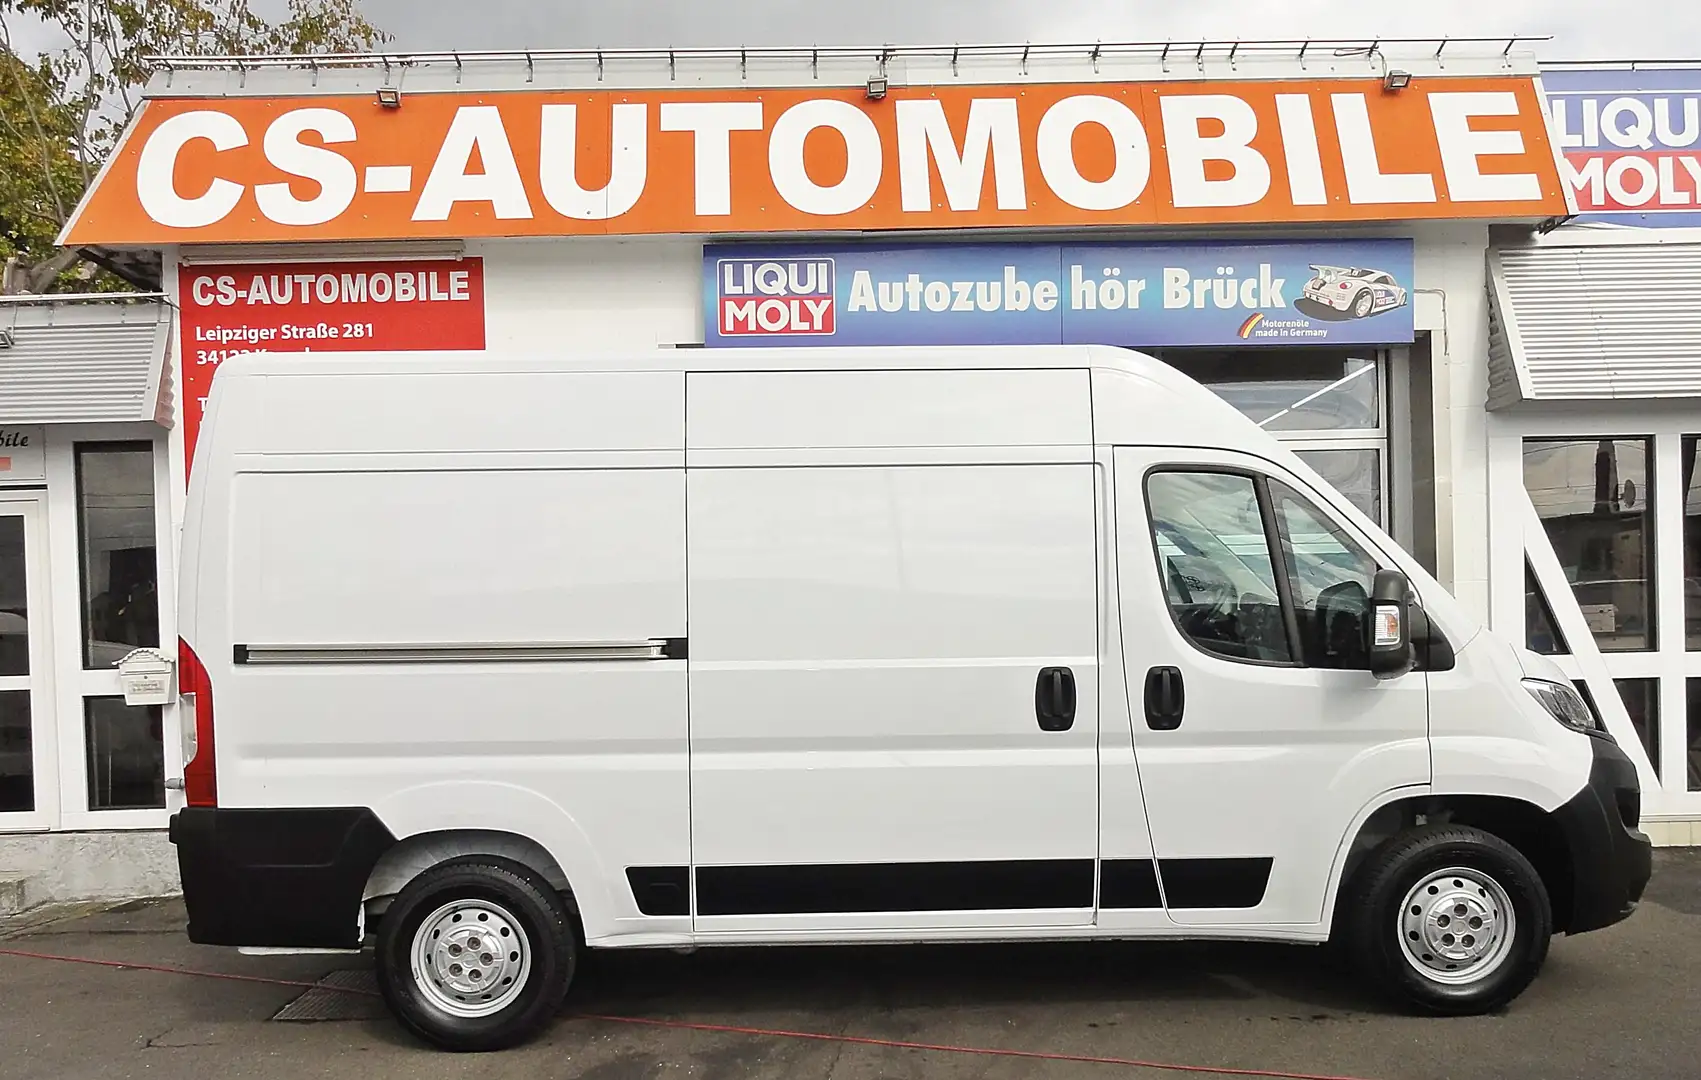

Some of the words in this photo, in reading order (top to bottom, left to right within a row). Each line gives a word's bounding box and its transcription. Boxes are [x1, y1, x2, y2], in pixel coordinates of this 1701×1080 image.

[136, 91, 1543, 228] CS-AUTOMOBILE
[192, 271, 471, 306] CS-AUTOMOBILE
[724, 262, 829, 297] LIQUI
[848, 266, 1059, 312] Autozube
[1071, 264, 1146, 310] hör
[1163, 263, 1287, 309] Brück
[724, 298, 834, 332] MOLY
[1261, 319, 1310, 328] Motorenöle
[195, 324, 278, 344] Leipziger
[280, 322, 339, 339] Straße
[342, 323, 374, 338] 281
[1255, 328, 1279, 337] made
[1289, 328, 1328, 339] Germany
[196, 349, 250, 365] 341
